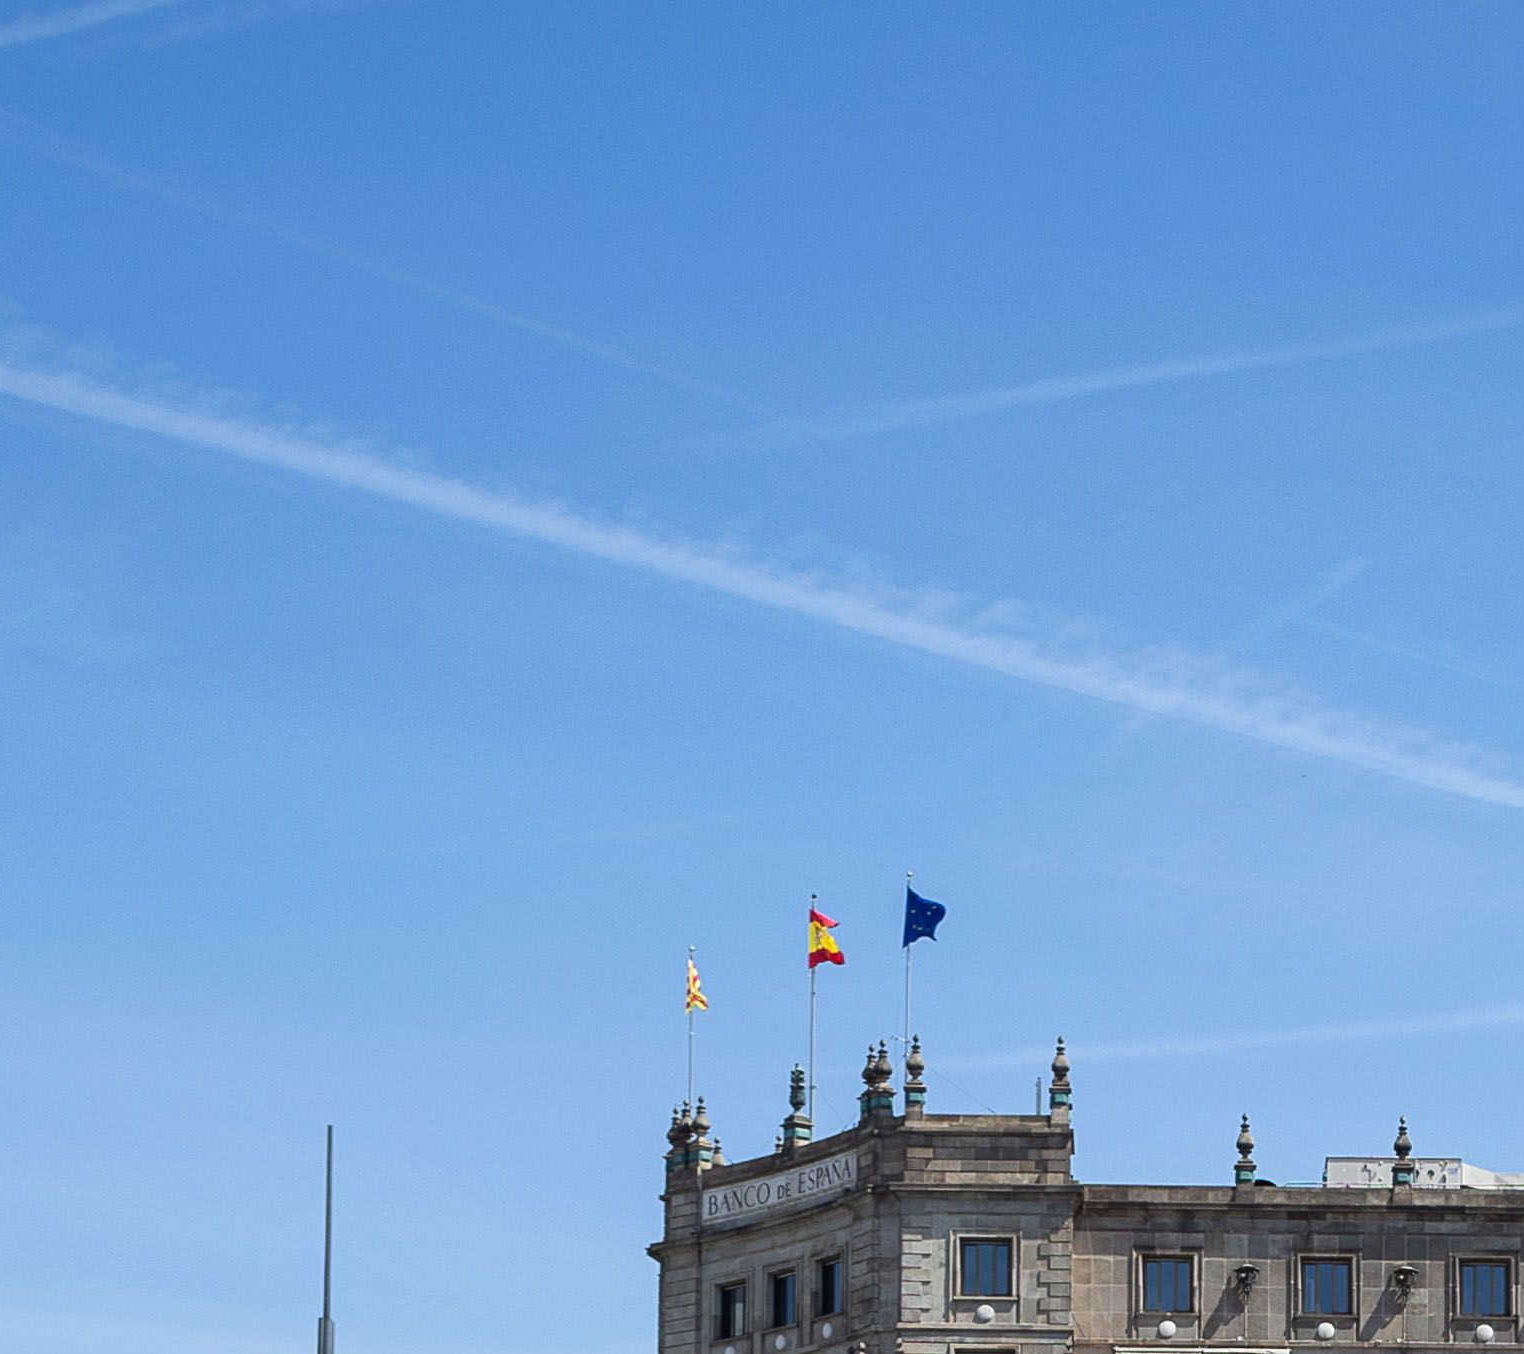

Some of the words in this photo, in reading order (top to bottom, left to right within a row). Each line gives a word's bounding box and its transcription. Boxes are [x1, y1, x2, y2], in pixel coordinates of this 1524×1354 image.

[708, 1182, 771, 1216] BANCO
[777, 1182, 791, 1200] DE
[797, 1158, 852, 1194] ESPAÑA
